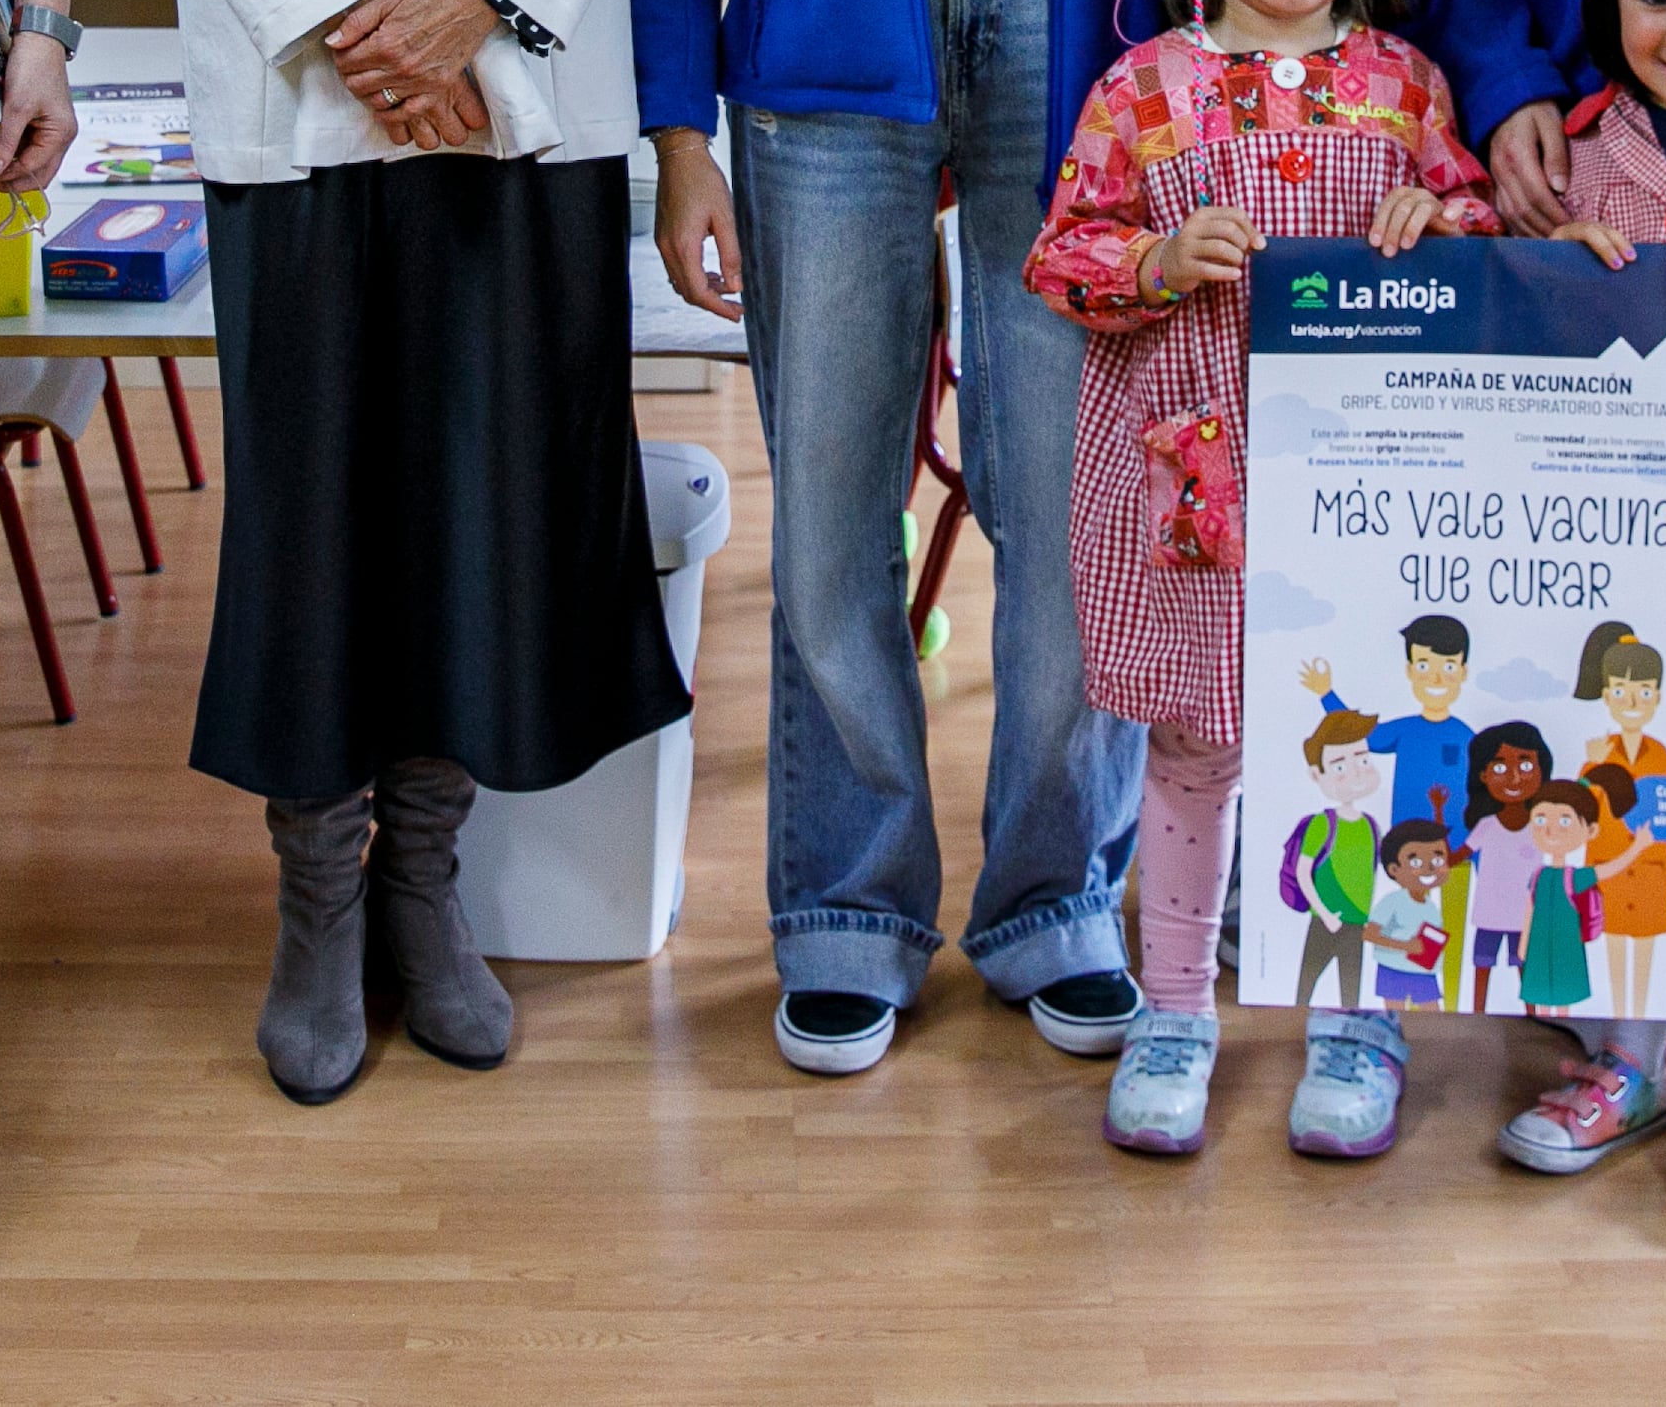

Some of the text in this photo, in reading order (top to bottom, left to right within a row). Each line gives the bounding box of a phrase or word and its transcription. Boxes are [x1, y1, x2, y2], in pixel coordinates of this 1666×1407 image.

[1338, 278, 1456, 315] La Rioja
[1290, 323, 1422, 339] larioja.org/vacunacion
[1385, 368, 1632, 395] CAMPAÑA DE VACUNACIÓN
[1340, 394, 1387, 410] GRIPE,
[1391, 394, 1435, 411] COVID
[1438, 396, 1447, 410] Y
[1451, 396, 1495, 412] VIRUS
[1498, 397, 1602, 416] RESPIRATORIO
[1312, 480, 1391, 538] Más
[1408, 490, 1503, 540] vale
[1400, 554, 1611, 610] que curar
